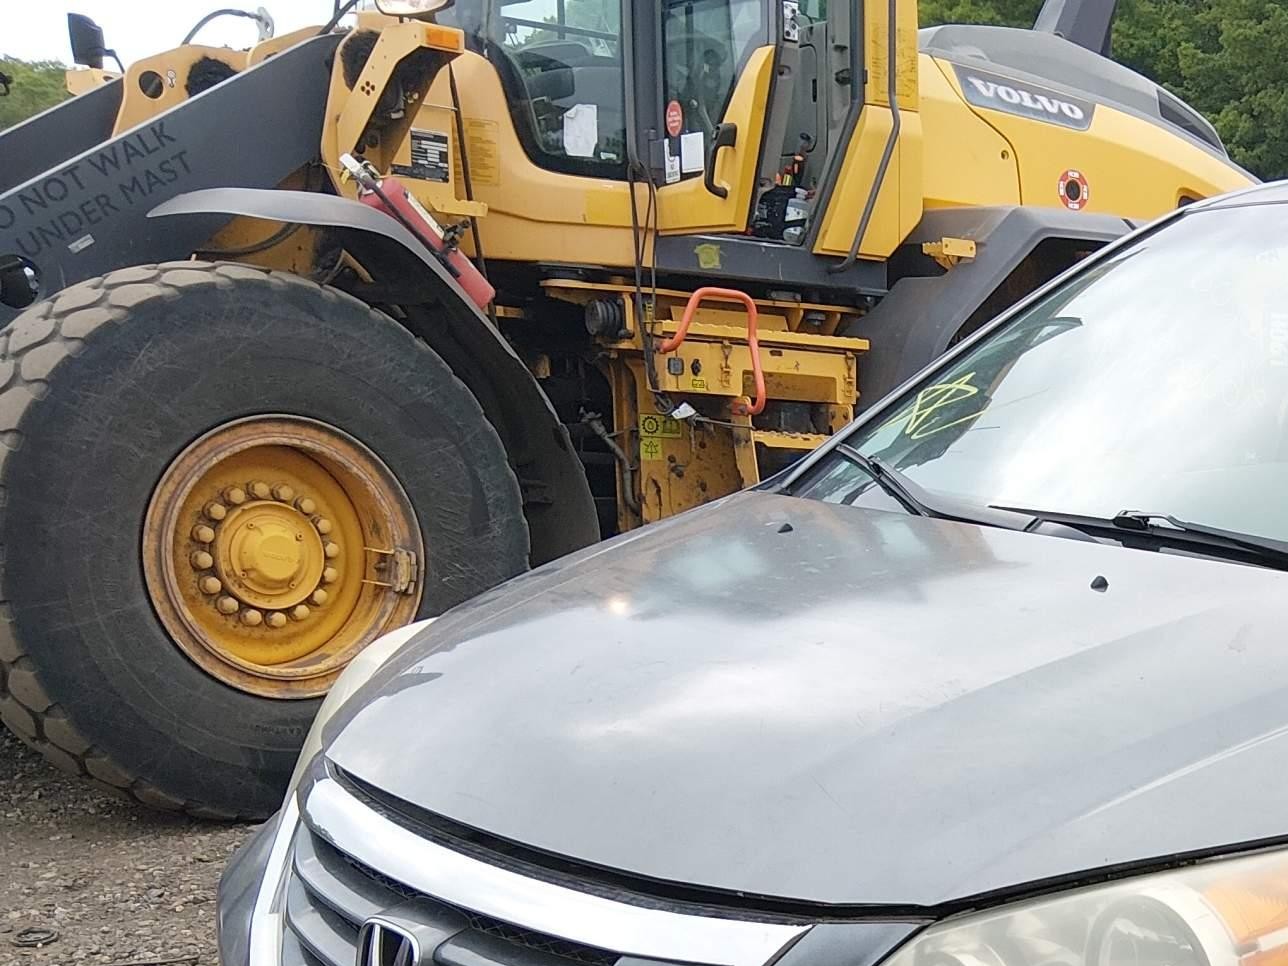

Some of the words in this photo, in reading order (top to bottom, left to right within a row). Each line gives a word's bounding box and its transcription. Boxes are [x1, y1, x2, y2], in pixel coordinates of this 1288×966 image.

[967, 76, 1084, 120] VOLVO
[16, 194, 120, 257] UNDER
[119, 150, 191, 204] MAST
[17, 165, 85, 215] NOT
[88, 121, 176, 177] WALK
